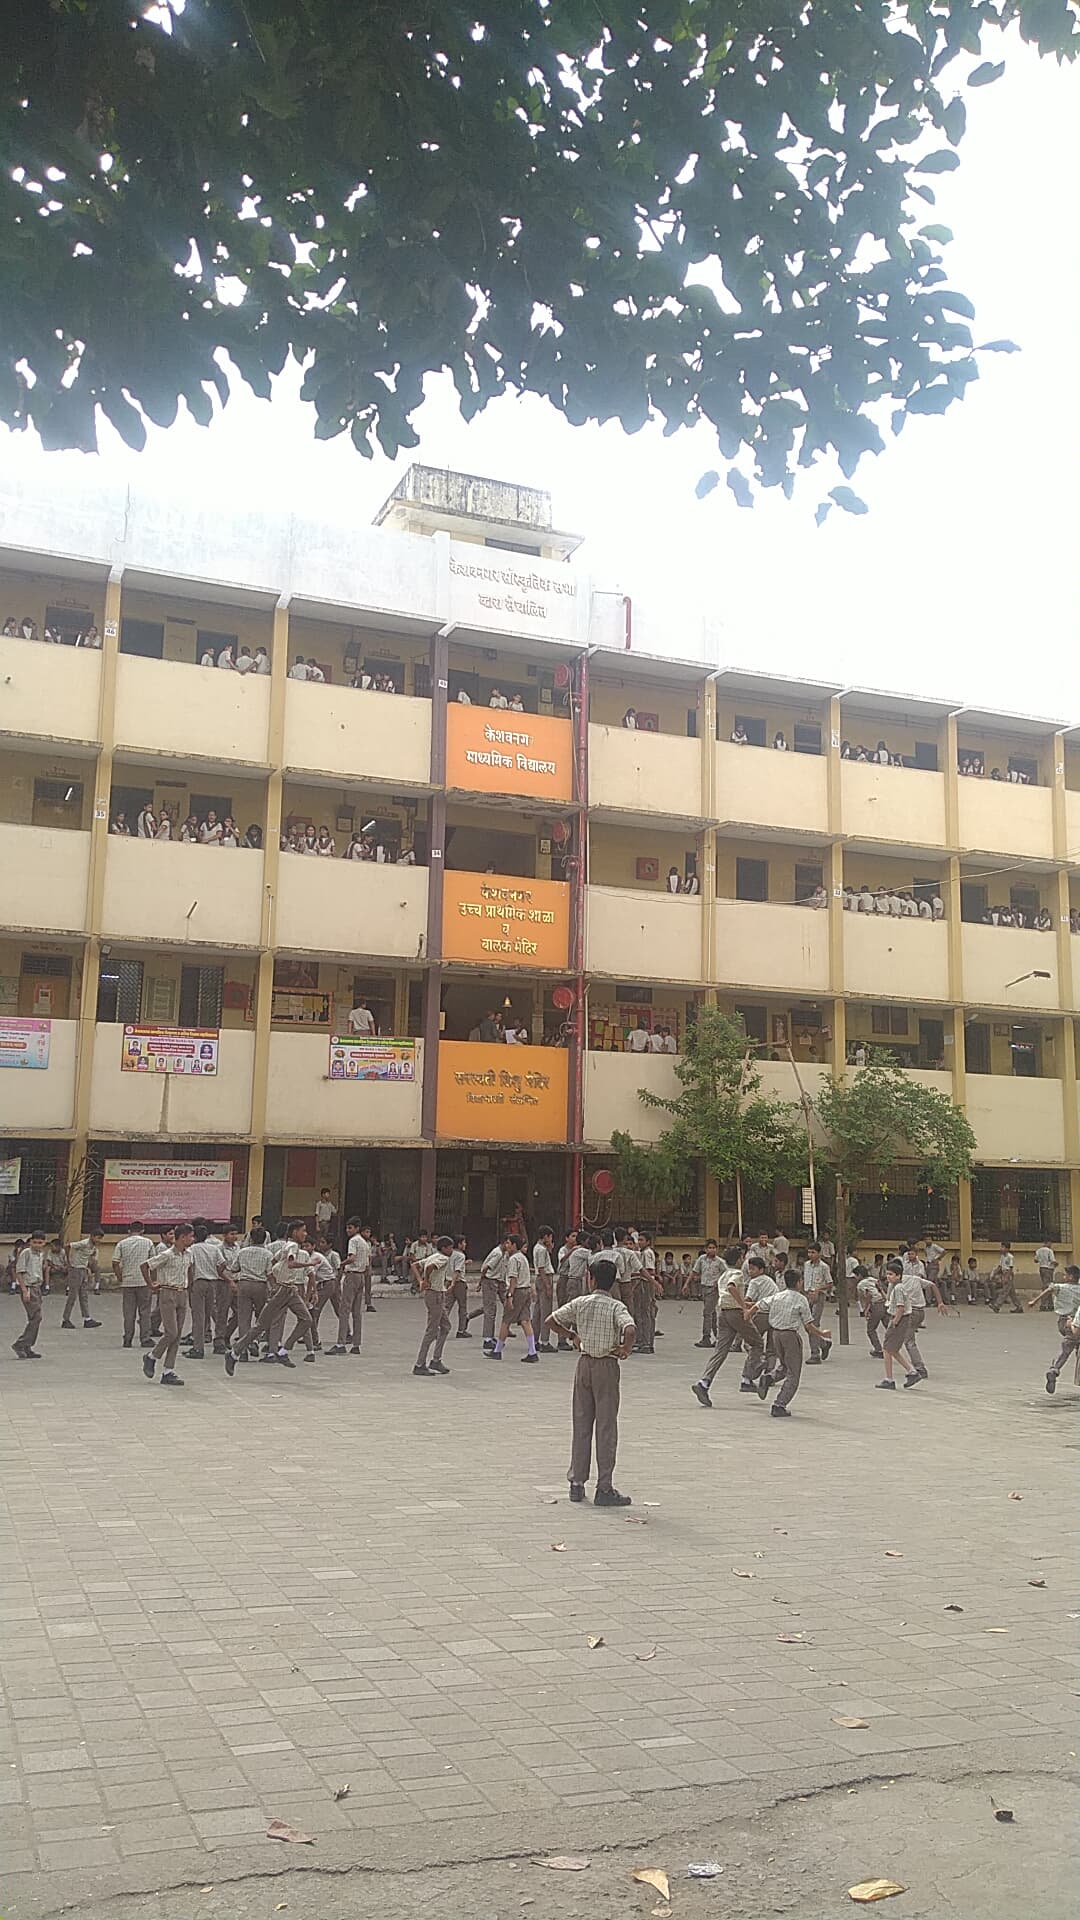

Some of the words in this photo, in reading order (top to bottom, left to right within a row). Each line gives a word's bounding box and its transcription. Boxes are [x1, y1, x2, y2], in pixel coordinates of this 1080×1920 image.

[466, 750, 513, 768] माध्यमिक
[516, 754, 556, 774] विद्यालय
[459, 902, 482, 917] उच्च
[485, 904, 526, 921] प्राथमिक
[528, 909, 554, 923] शाळा
[121, 1168, 161, 1177] सरस्वती
[164, 1168, 188, 1178] शिशु
[190, 1168, 216, 1177] मंदिर
